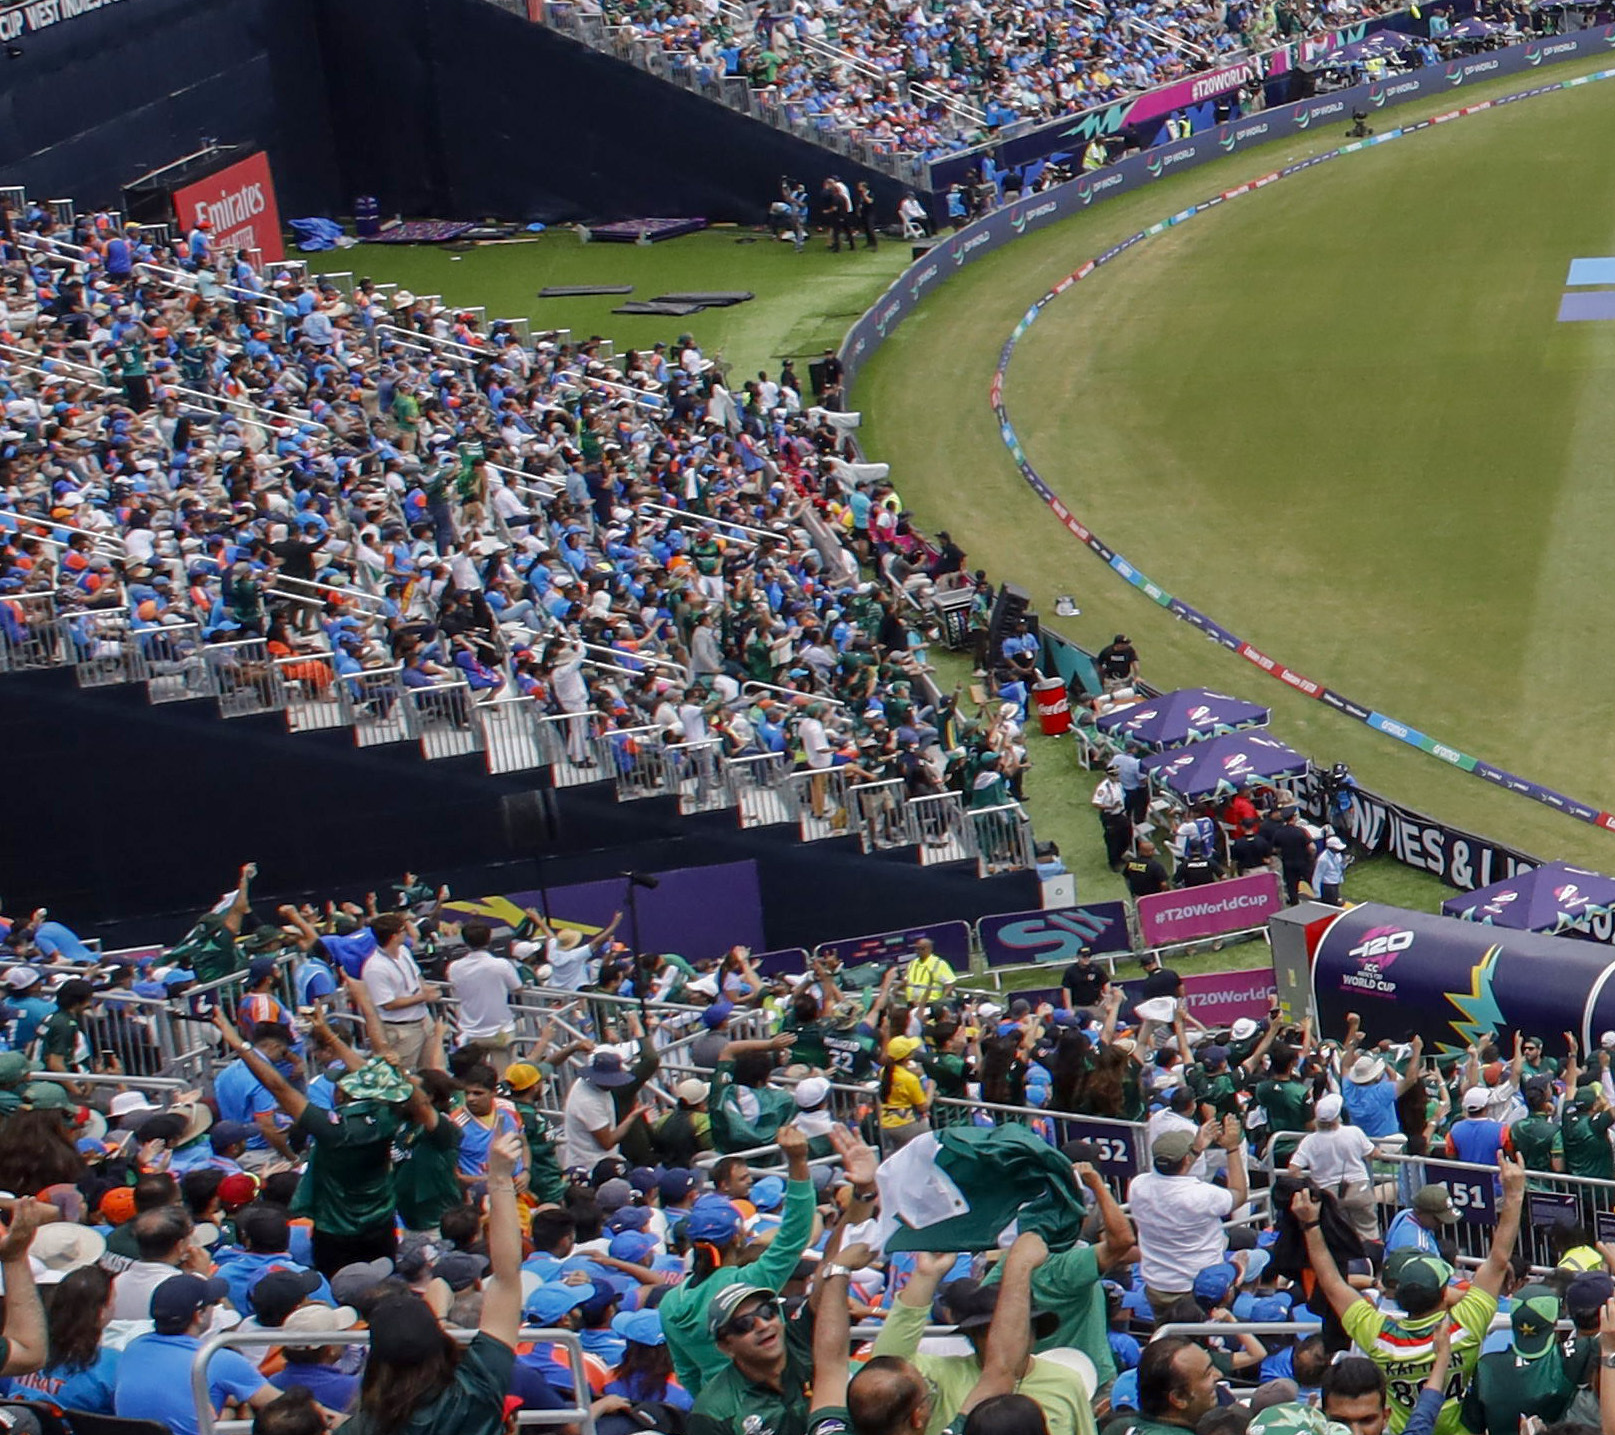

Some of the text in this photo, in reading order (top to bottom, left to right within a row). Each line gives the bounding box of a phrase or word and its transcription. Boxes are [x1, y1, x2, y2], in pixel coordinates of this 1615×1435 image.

[195, 182, 266, 235] Emirates
[1450, 842, 1476, 890] &
[1155, 894, 1268, 925] #T20WorldCup
[996, 907, 1115, 966] SIX
[1363, 963, 1380, 972] ICC
[1342, 975, 1397, 993] WORLD CUP
[1438, 1179, 1486, 1209] 151
